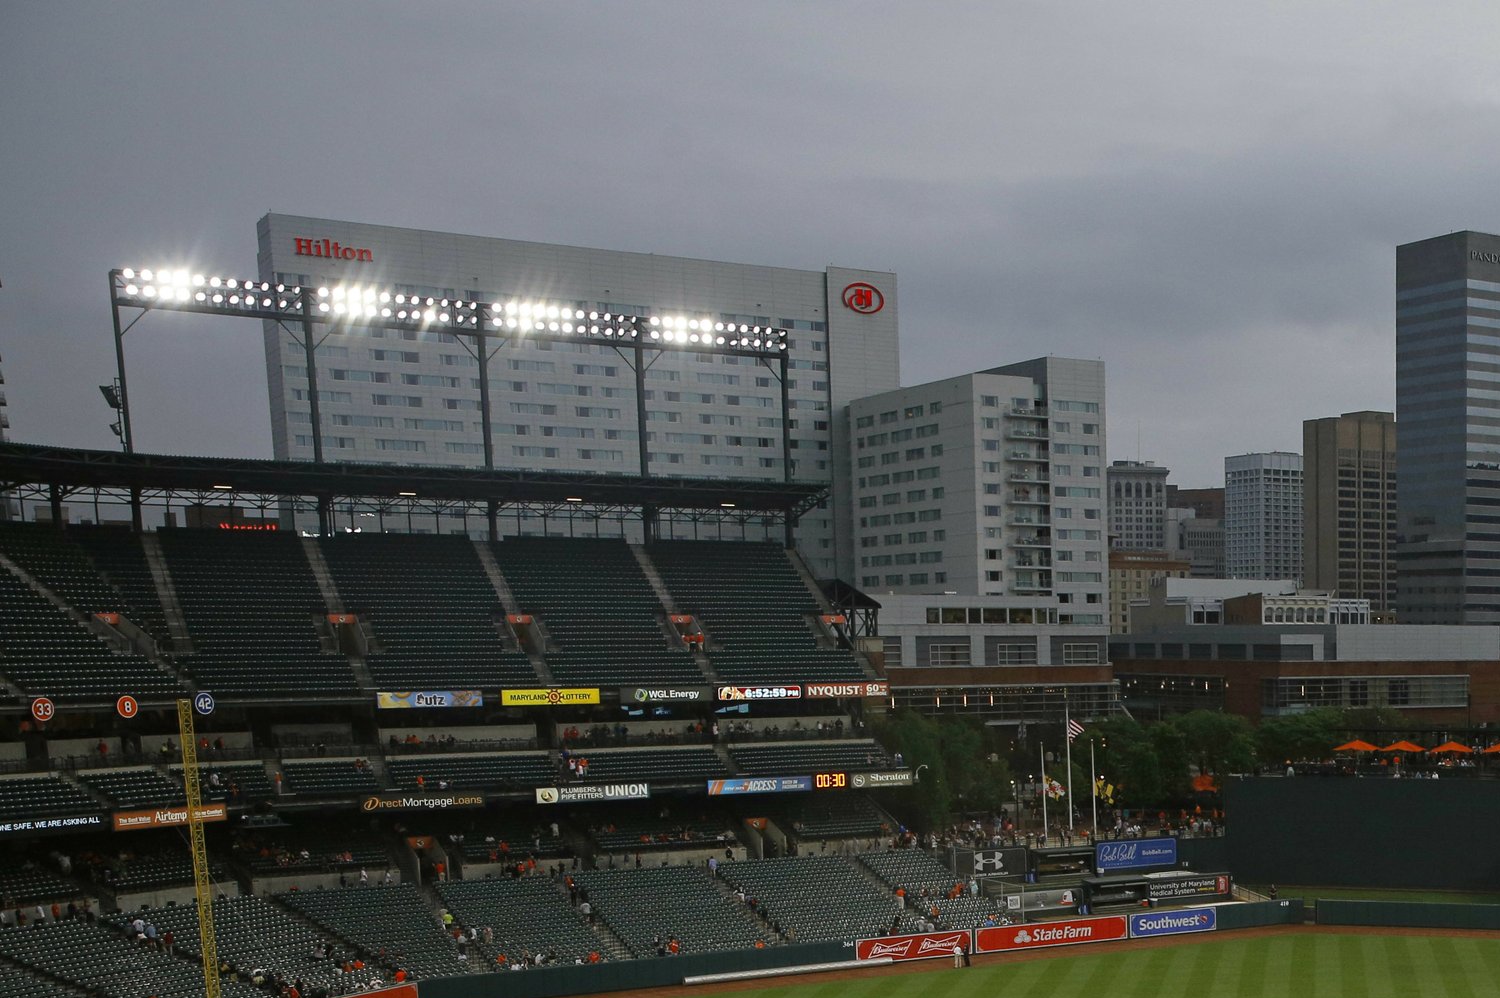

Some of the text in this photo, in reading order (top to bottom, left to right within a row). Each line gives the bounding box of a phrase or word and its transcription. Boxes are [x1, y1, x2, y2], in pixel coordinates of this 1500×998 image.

[294, 236, 373, 262] Hilton
[648, 690, 699, 700] WGL Energy
[744, 688, 786, 698] 6:52:59
[808, 685, 858, 696] NYQUIST
[866, 684, 879, 692] 60
[124, 702, 132, 712] 8
[198, 698, 211, 709] 42
[36, 704, 52, 716] 33
[817, 774, 845, 788] 00:30
[870, 774, 909, 782] Sheraton
[605, 784, 648, 797] UNION
[749, 780, 777, 791] ACCESS
[62, 818, 87, 826] ASKING
[154, 811, 187, 822] Airtemp
[1100, 844, 1136, 862] Bob Bell
[1142, 848, 1172, 856] BobBell.com
[1150, 882, 1180, 890] University
[1188, 879, 1215, 888] Maryland
[1174, 887, 1195, 895] System
[1139, 914, 1200, 932] Southwest
[873, 946, 908, 954] Budweiser
[922, 940, 957, 949] Budweiser
